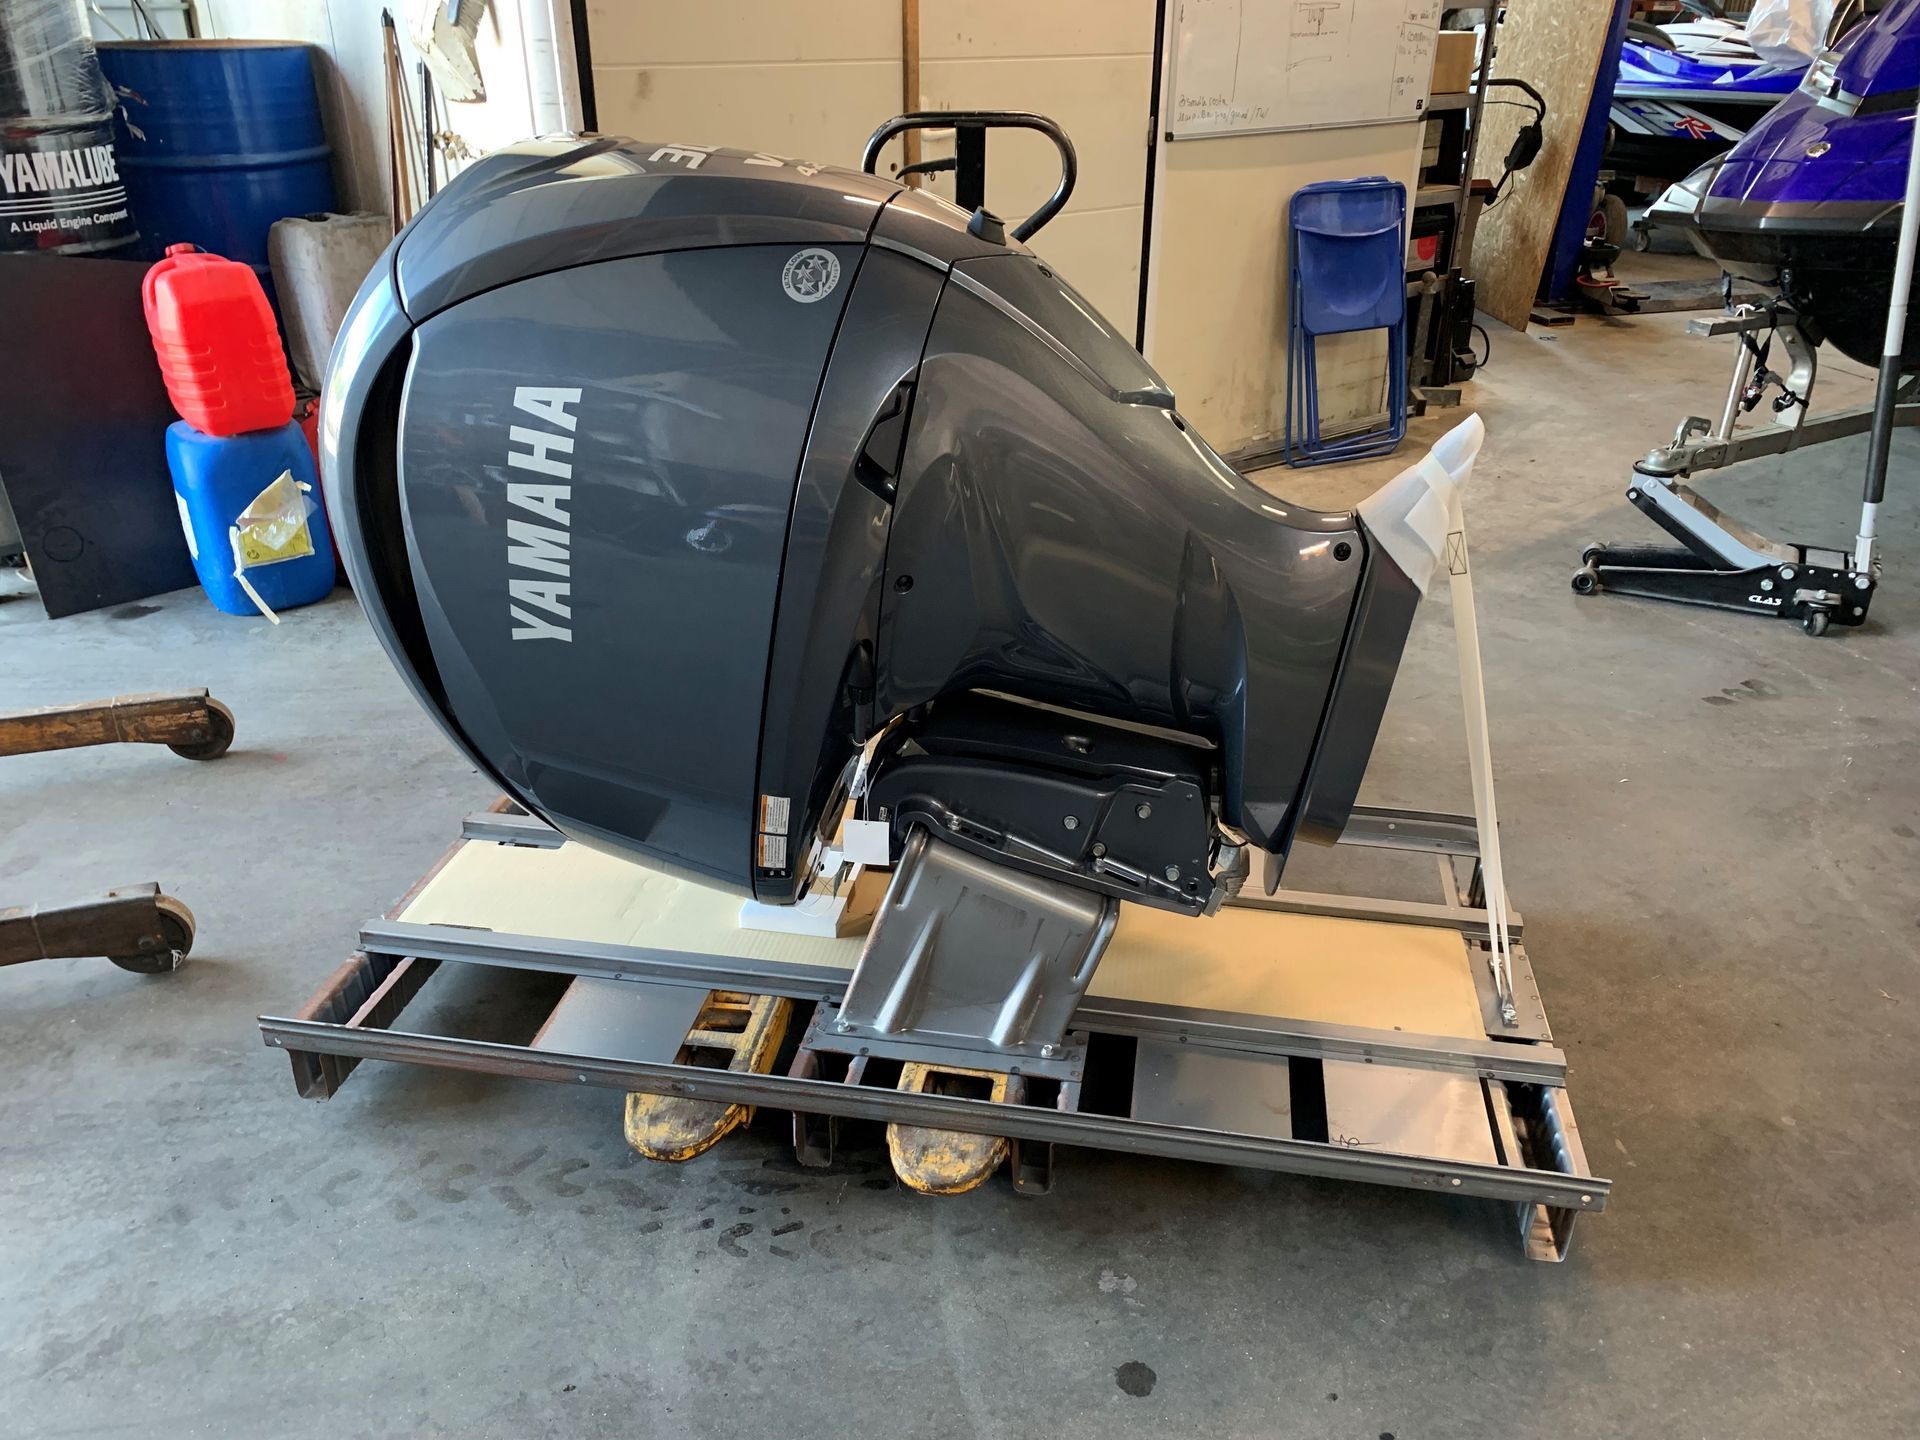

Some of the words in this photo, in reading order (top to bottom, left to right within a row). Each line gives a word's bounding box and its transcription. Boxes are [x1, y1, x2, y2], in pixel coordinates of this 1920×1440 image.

[0, 144, 120, 193] YAMALUBE
[10, 221, 21, 233] A
[22, 218, 58, 234] Liquid
[60, 214, 92, 230] Engine
[783, 267, 792, 290] ULTRA
[506, 386, 583, 643] YAMAHA
[1748, 594, 1783, 606] CLAS
